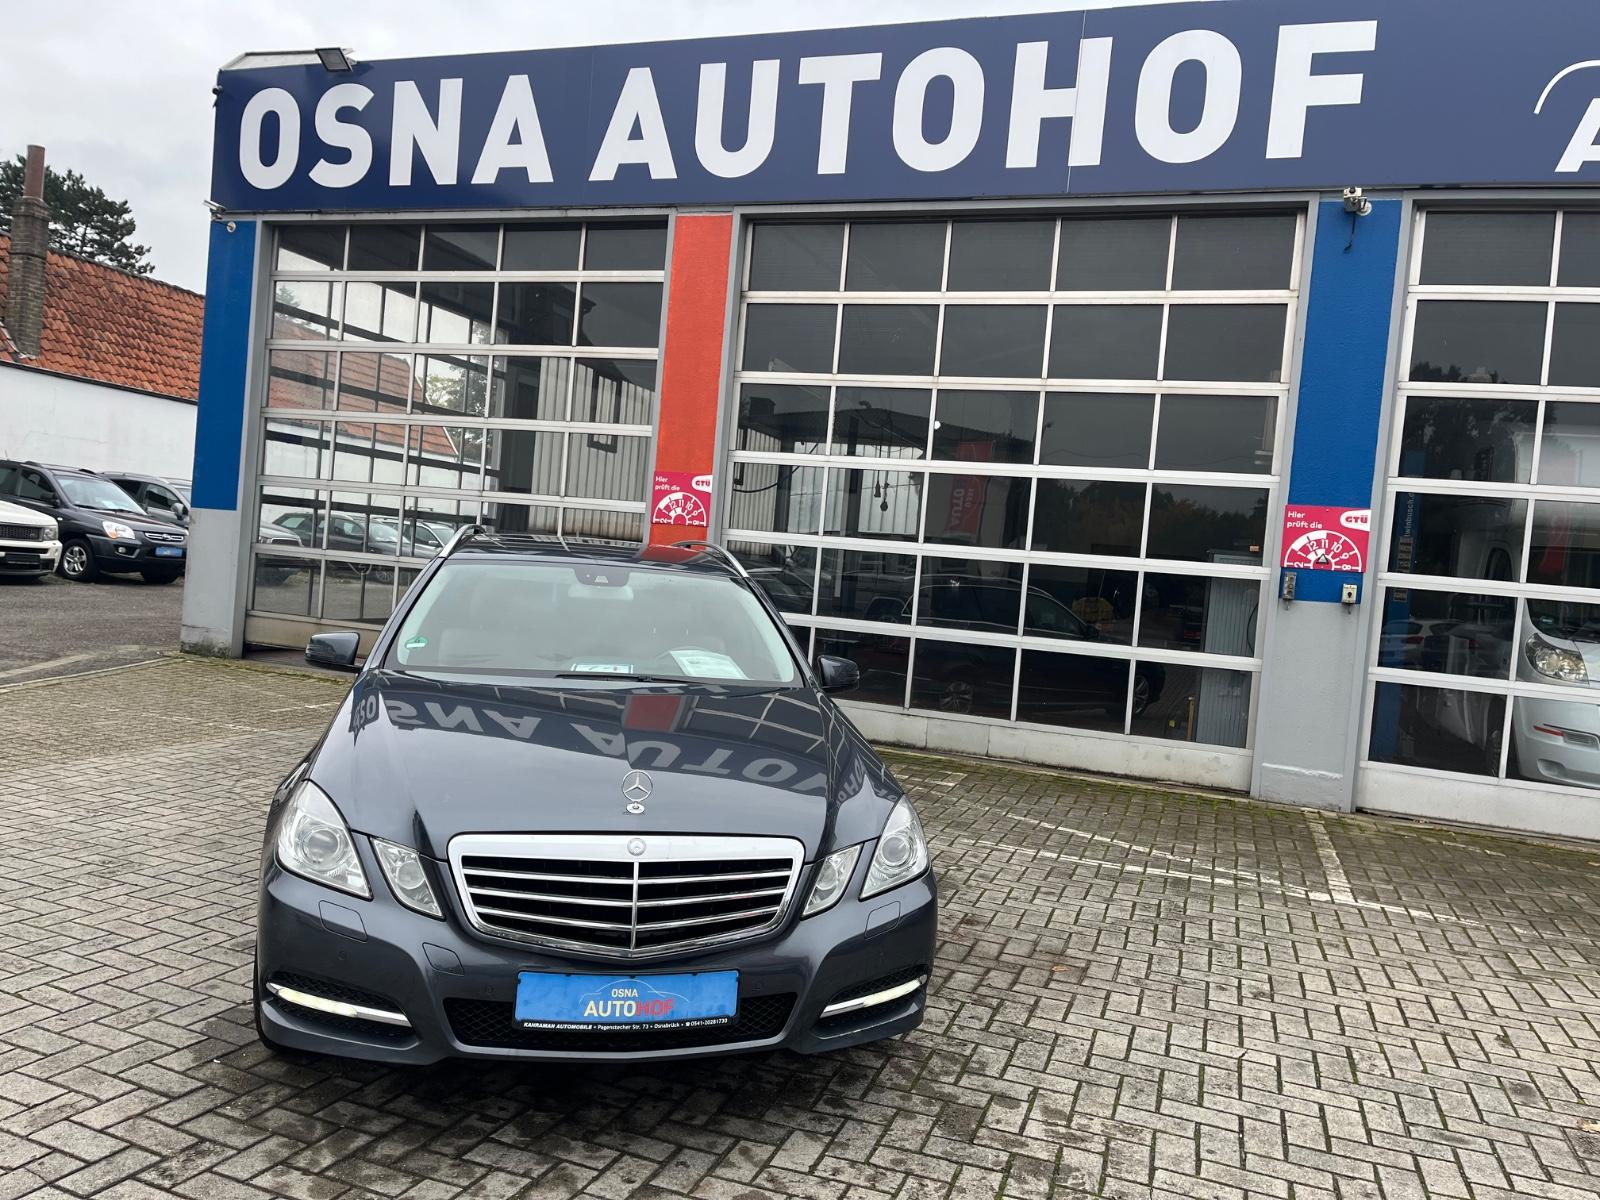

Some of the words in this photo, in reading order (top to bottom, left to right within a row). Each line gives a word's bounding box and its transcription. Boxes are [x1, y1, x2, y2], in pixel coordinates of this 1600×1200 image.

[238, 74, 554, 189] OSNA
[587, 19, 1378, 182] AUTOHOF
[1287, 511, 1306, 519] Hier
[1344, 515, 1368, 524] GTÜ
[1286, 521, 1309, 529] prüft
[1310, 521, 1323, 529] die
[1306, 540, 1318, 551] 12
[1321, 539, 1329, 548] 11
[1331, 541, 1342, 553] 10
[611, 988, 638, 998] OSNA
[583, 998, 674, 1017] AUTOHOF
